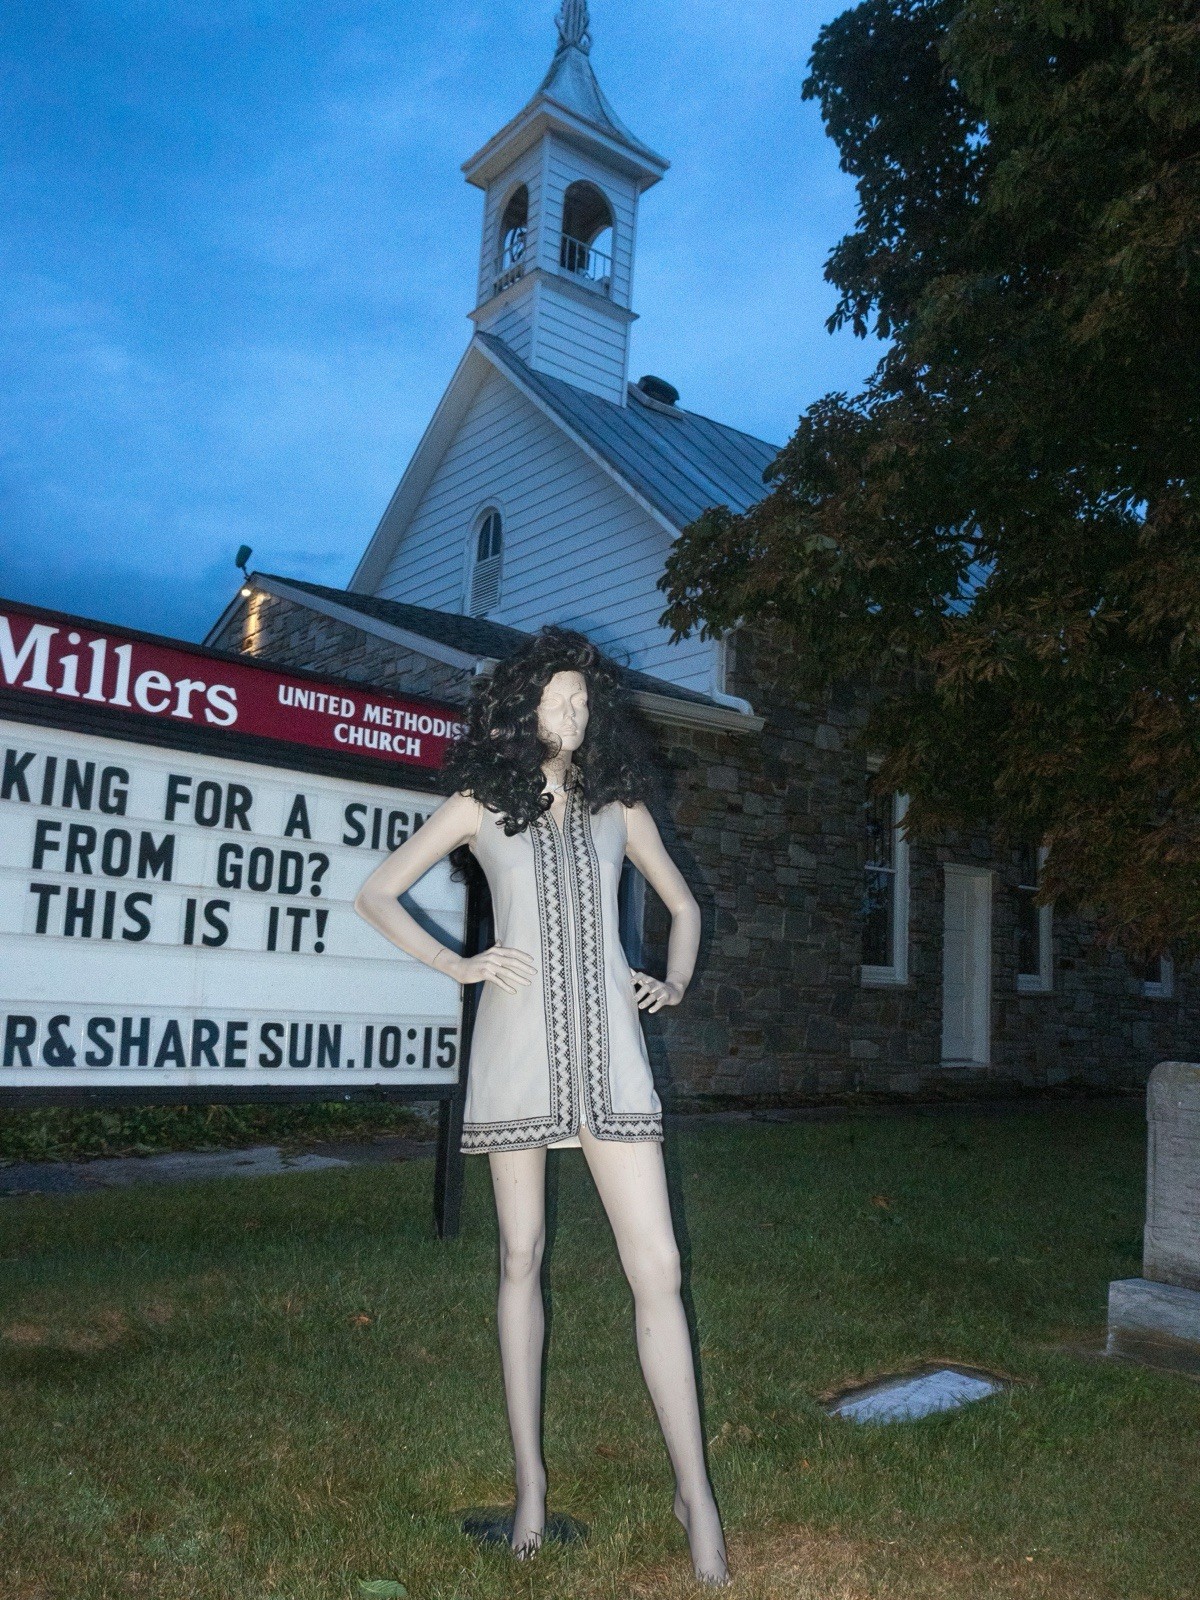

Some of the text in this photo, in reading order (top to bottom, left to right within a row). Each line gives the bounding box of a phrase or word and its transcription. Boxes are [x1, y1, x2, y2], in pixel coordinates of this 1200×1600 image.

[0, 614, 239, 728] Millers
[278, 684, 356, 719] UNITED
[334, 723, 421, 758] CHURCH
[1, 748, 130, 817] KING
[165, 774, 254, 832] FOR
[284, 793, 312, 840] A
[31, 819, 331, 898] FROM GOD?
[29, 883, 330, 954] THIS IS IT!
